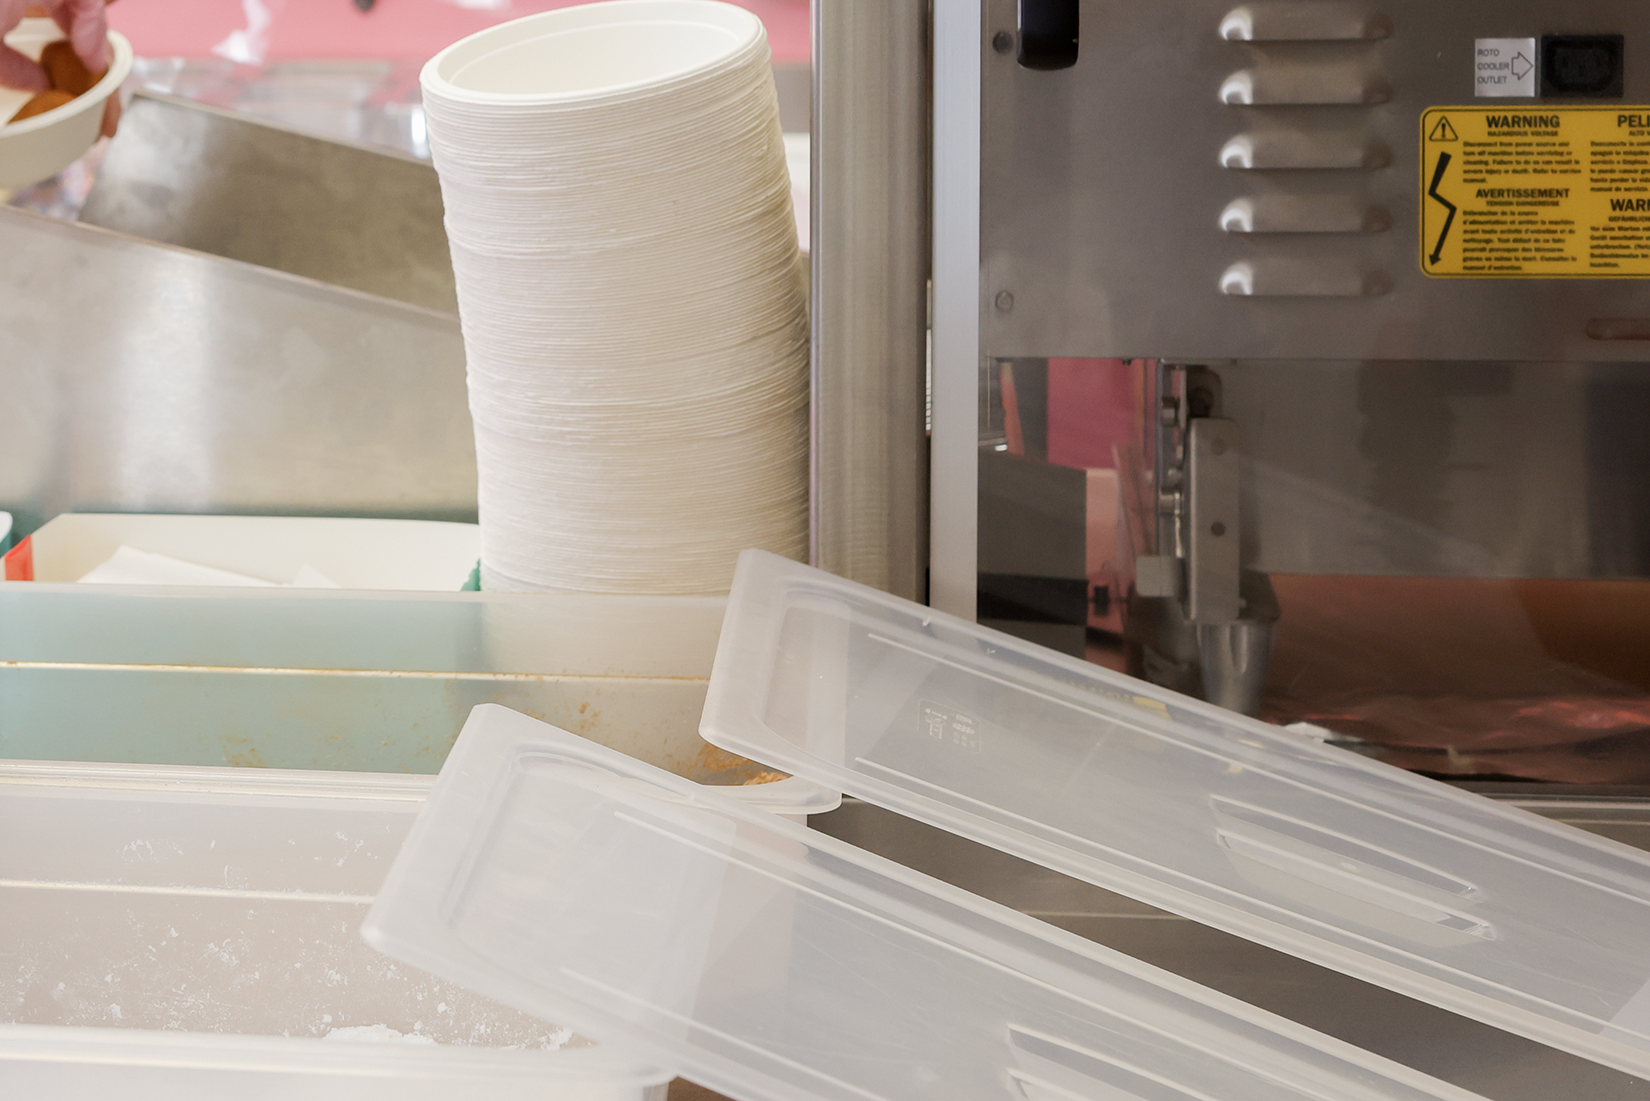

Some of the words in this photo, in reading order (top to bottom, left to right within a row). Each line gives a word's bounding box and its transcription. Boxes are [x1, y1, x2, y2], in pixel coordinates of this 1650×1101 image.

[1477, 62, 1510, 71] COOLER
[1477, 75, 1508, 84] OUTLET
[1486, 115, 1560, 128] WARNING
[1476, 188, 1570, 198] AVERTISSEMENT
